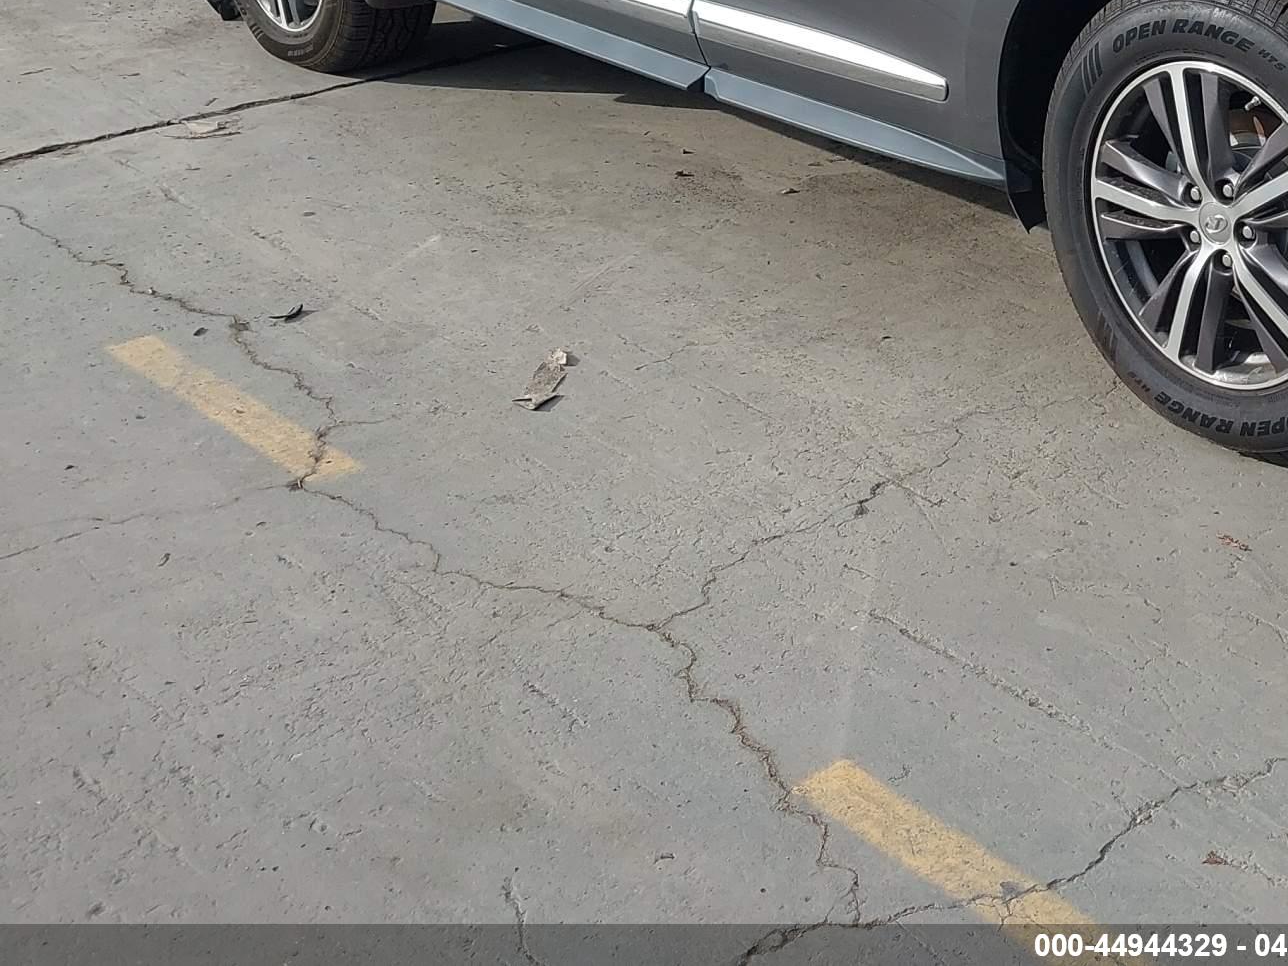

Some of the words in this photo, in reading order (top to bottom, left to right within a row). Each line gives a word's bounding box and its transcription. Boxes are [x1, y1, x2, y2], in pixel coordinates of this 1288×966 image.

[1112, 19, 1167, 54] OPEN
[1172, 18, 1255, 53] RANGE
[1153, 390, 1235, 434] RANGE
